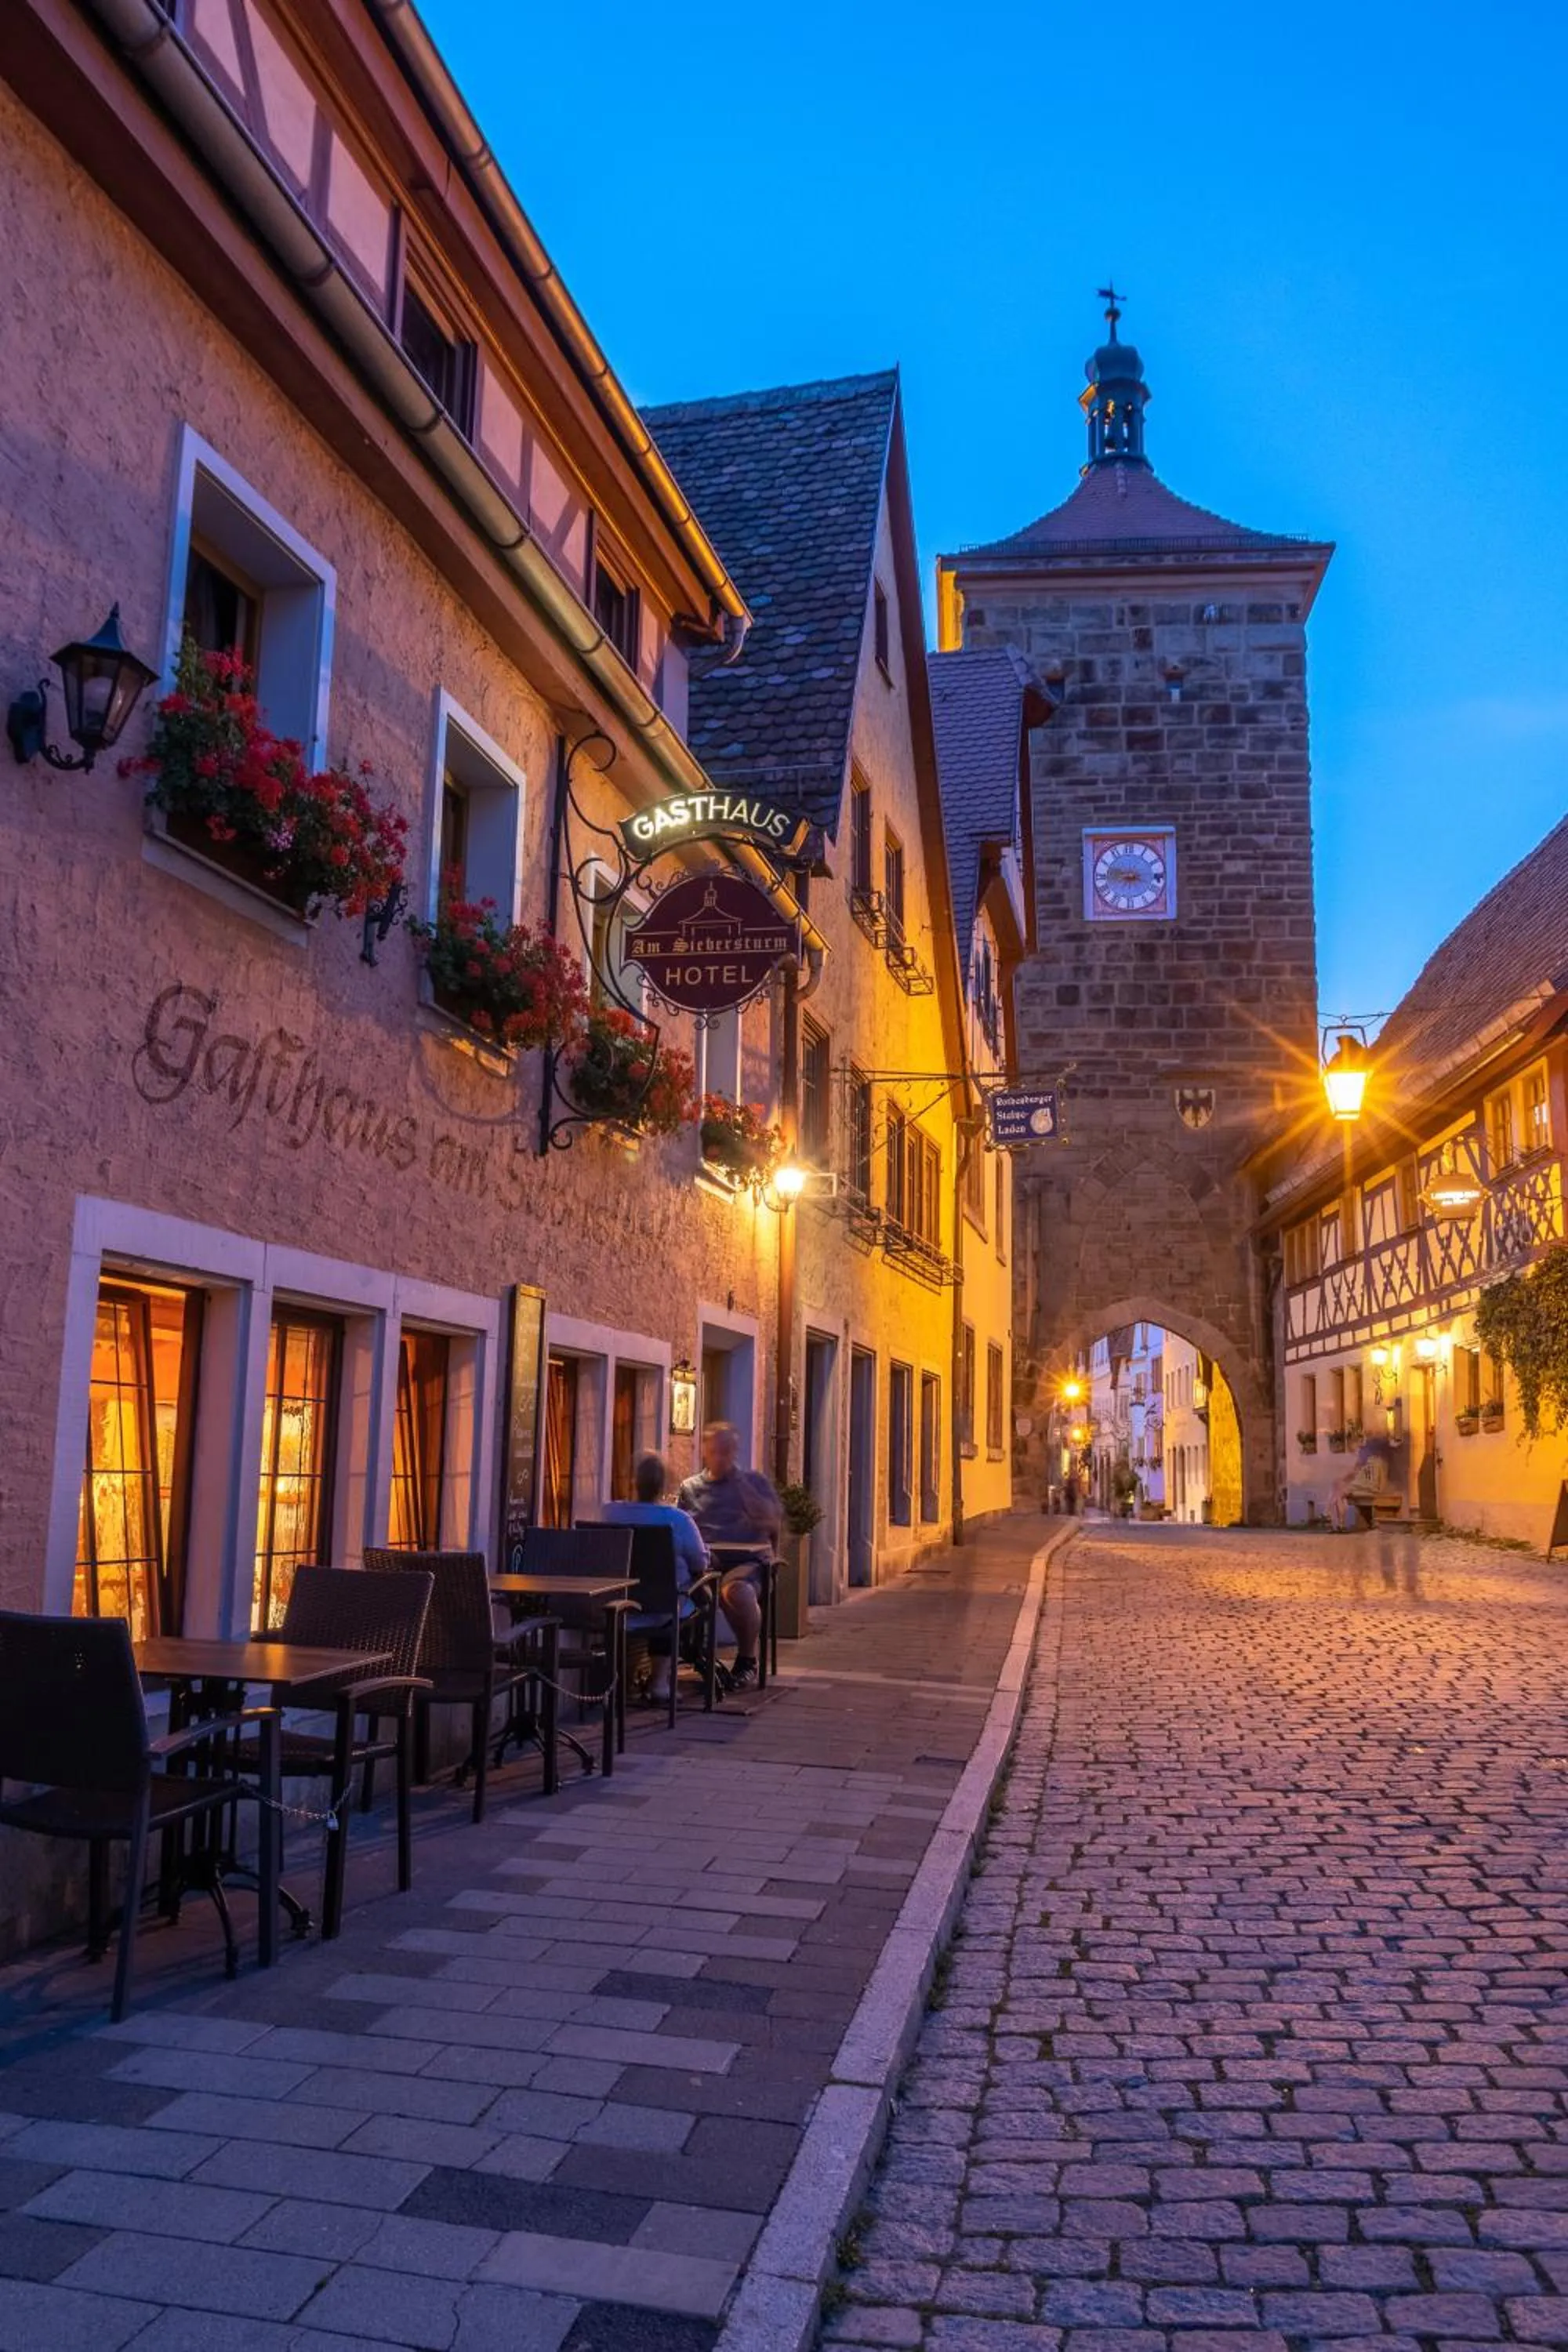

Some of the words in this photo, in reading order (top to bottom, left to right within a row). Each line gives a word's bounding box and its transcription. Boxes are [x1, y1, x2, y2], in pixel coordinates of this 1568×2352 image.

[631, 794, 791, 840] GASTHAUS
[631, 938, 661, 955] Am
[672, 937, 788, 953] Siebersturm
[666, 964, 753, 986] HOTEL
